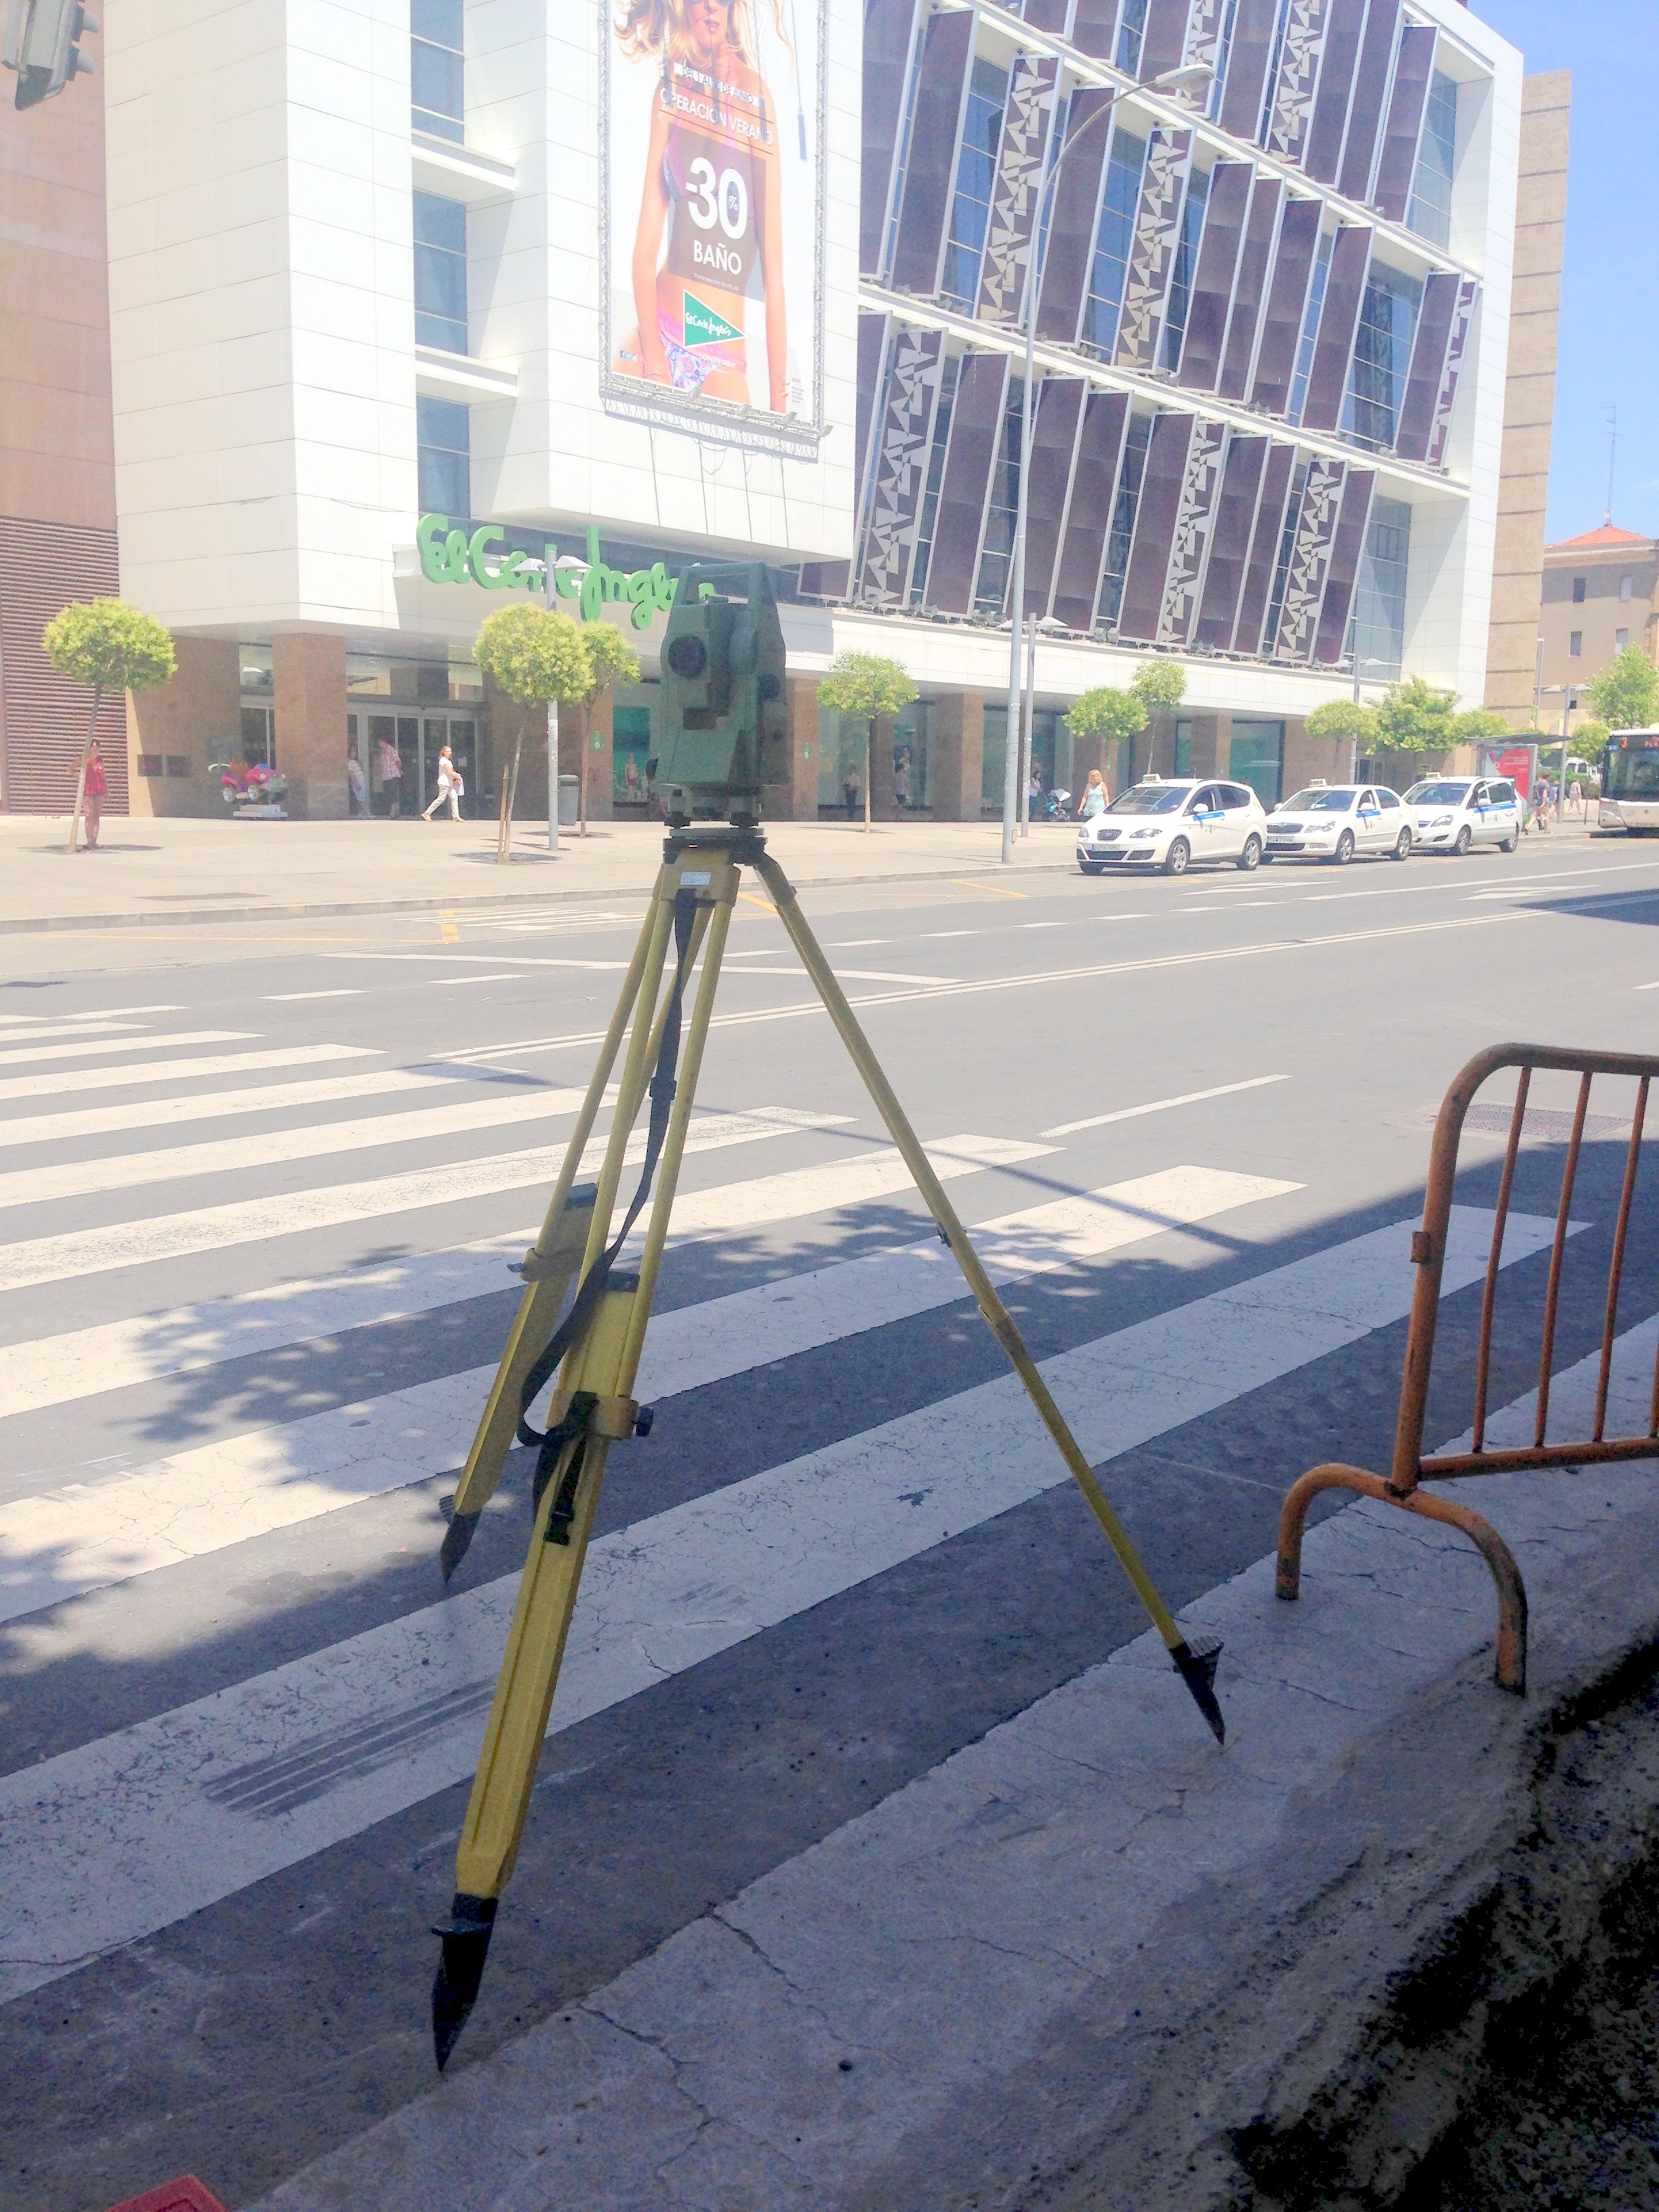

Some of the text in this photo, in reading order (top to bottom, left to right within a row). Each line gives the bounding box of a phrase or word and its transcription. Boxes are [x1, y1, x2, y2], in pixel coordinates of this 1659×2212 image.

[682, 66, 695, 80] DEL
[703, 76, 712, 87] AL
[722, 83, 732, 94] DE
[733, 89, 754, 104] JUNIO
[659, 87, 773, 146] OPERACIÓN VERANO
[693, 239, 742, 275] BAÑO
[685, 312, 732, 337] El Corte Inglés
[416, 513, 472, 584] El
[580, 525, 717, 630] Ingl
